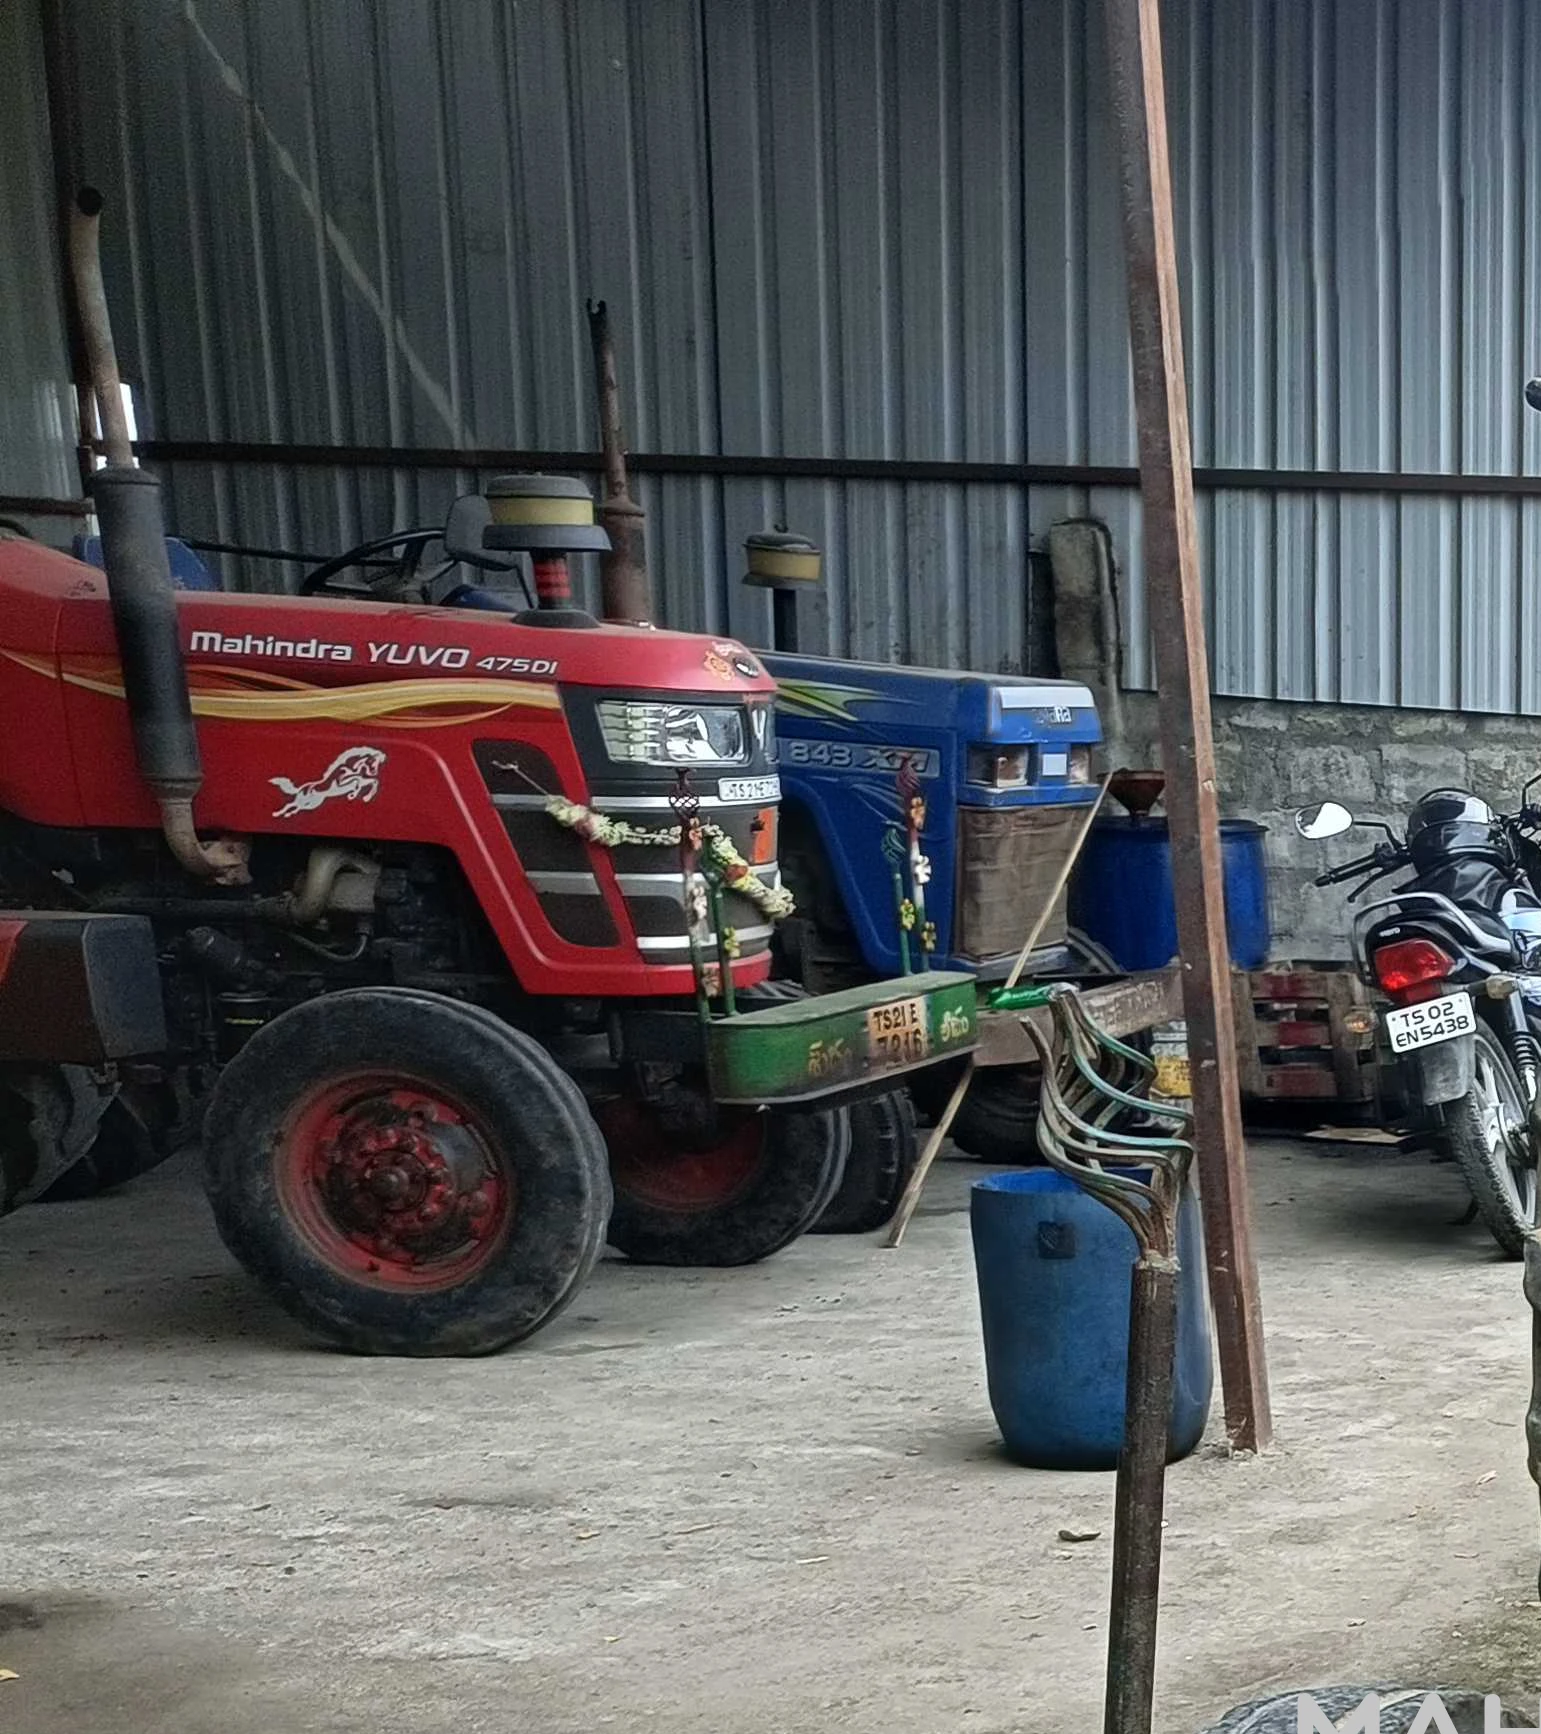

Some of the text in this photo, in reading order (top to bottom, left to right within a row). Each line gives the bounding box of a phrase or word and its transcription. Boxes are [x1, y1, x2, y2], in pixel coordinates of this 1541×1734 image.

[190, 631, 353, 661] Mahindra
[367, 642, 471, 668] YUVO
[789, 742, 852, 767] 843
[1400, 1001, 1455, 1027] TS 02
